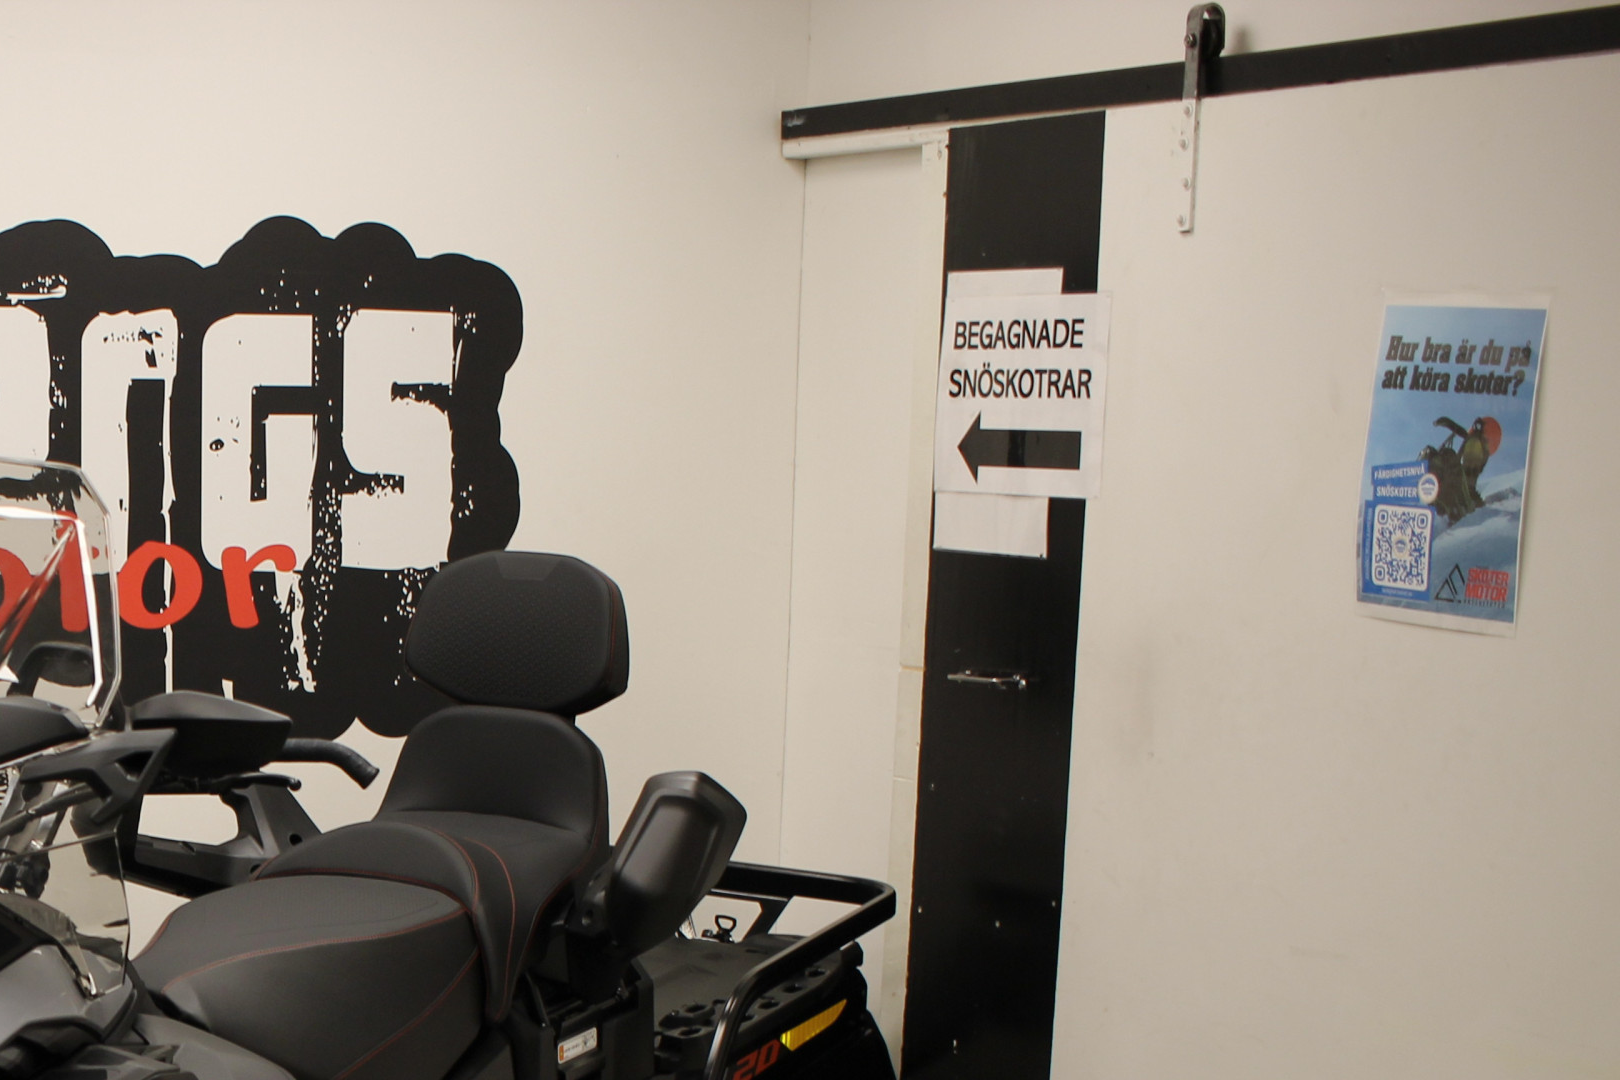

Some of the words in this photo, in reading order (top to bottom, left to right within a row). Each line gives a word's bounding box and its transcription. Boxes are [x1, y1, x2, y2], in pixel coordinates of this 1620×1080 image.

[953, 318, 1085, 350] BEGAGNADE
[1385, 335, 1420, 362] Hur
[1421, 336, 1453, 364] bra
[1455, 338, 1477, 365] är
[1478, 339, 1505, 366] du
[1504, 340, 1533, 373] på
[948, 362, 1092, 399] SNÖSKOTRAR
[1381, 365, 1408, 390] att
[1409, 365, 1451, 393] köra
[1376, 484, 1418, 498] SNÖSKOTER
[1467, 567, 1510, 586] SKOTER
[1465, 583, 1508, 603] MOTOR
